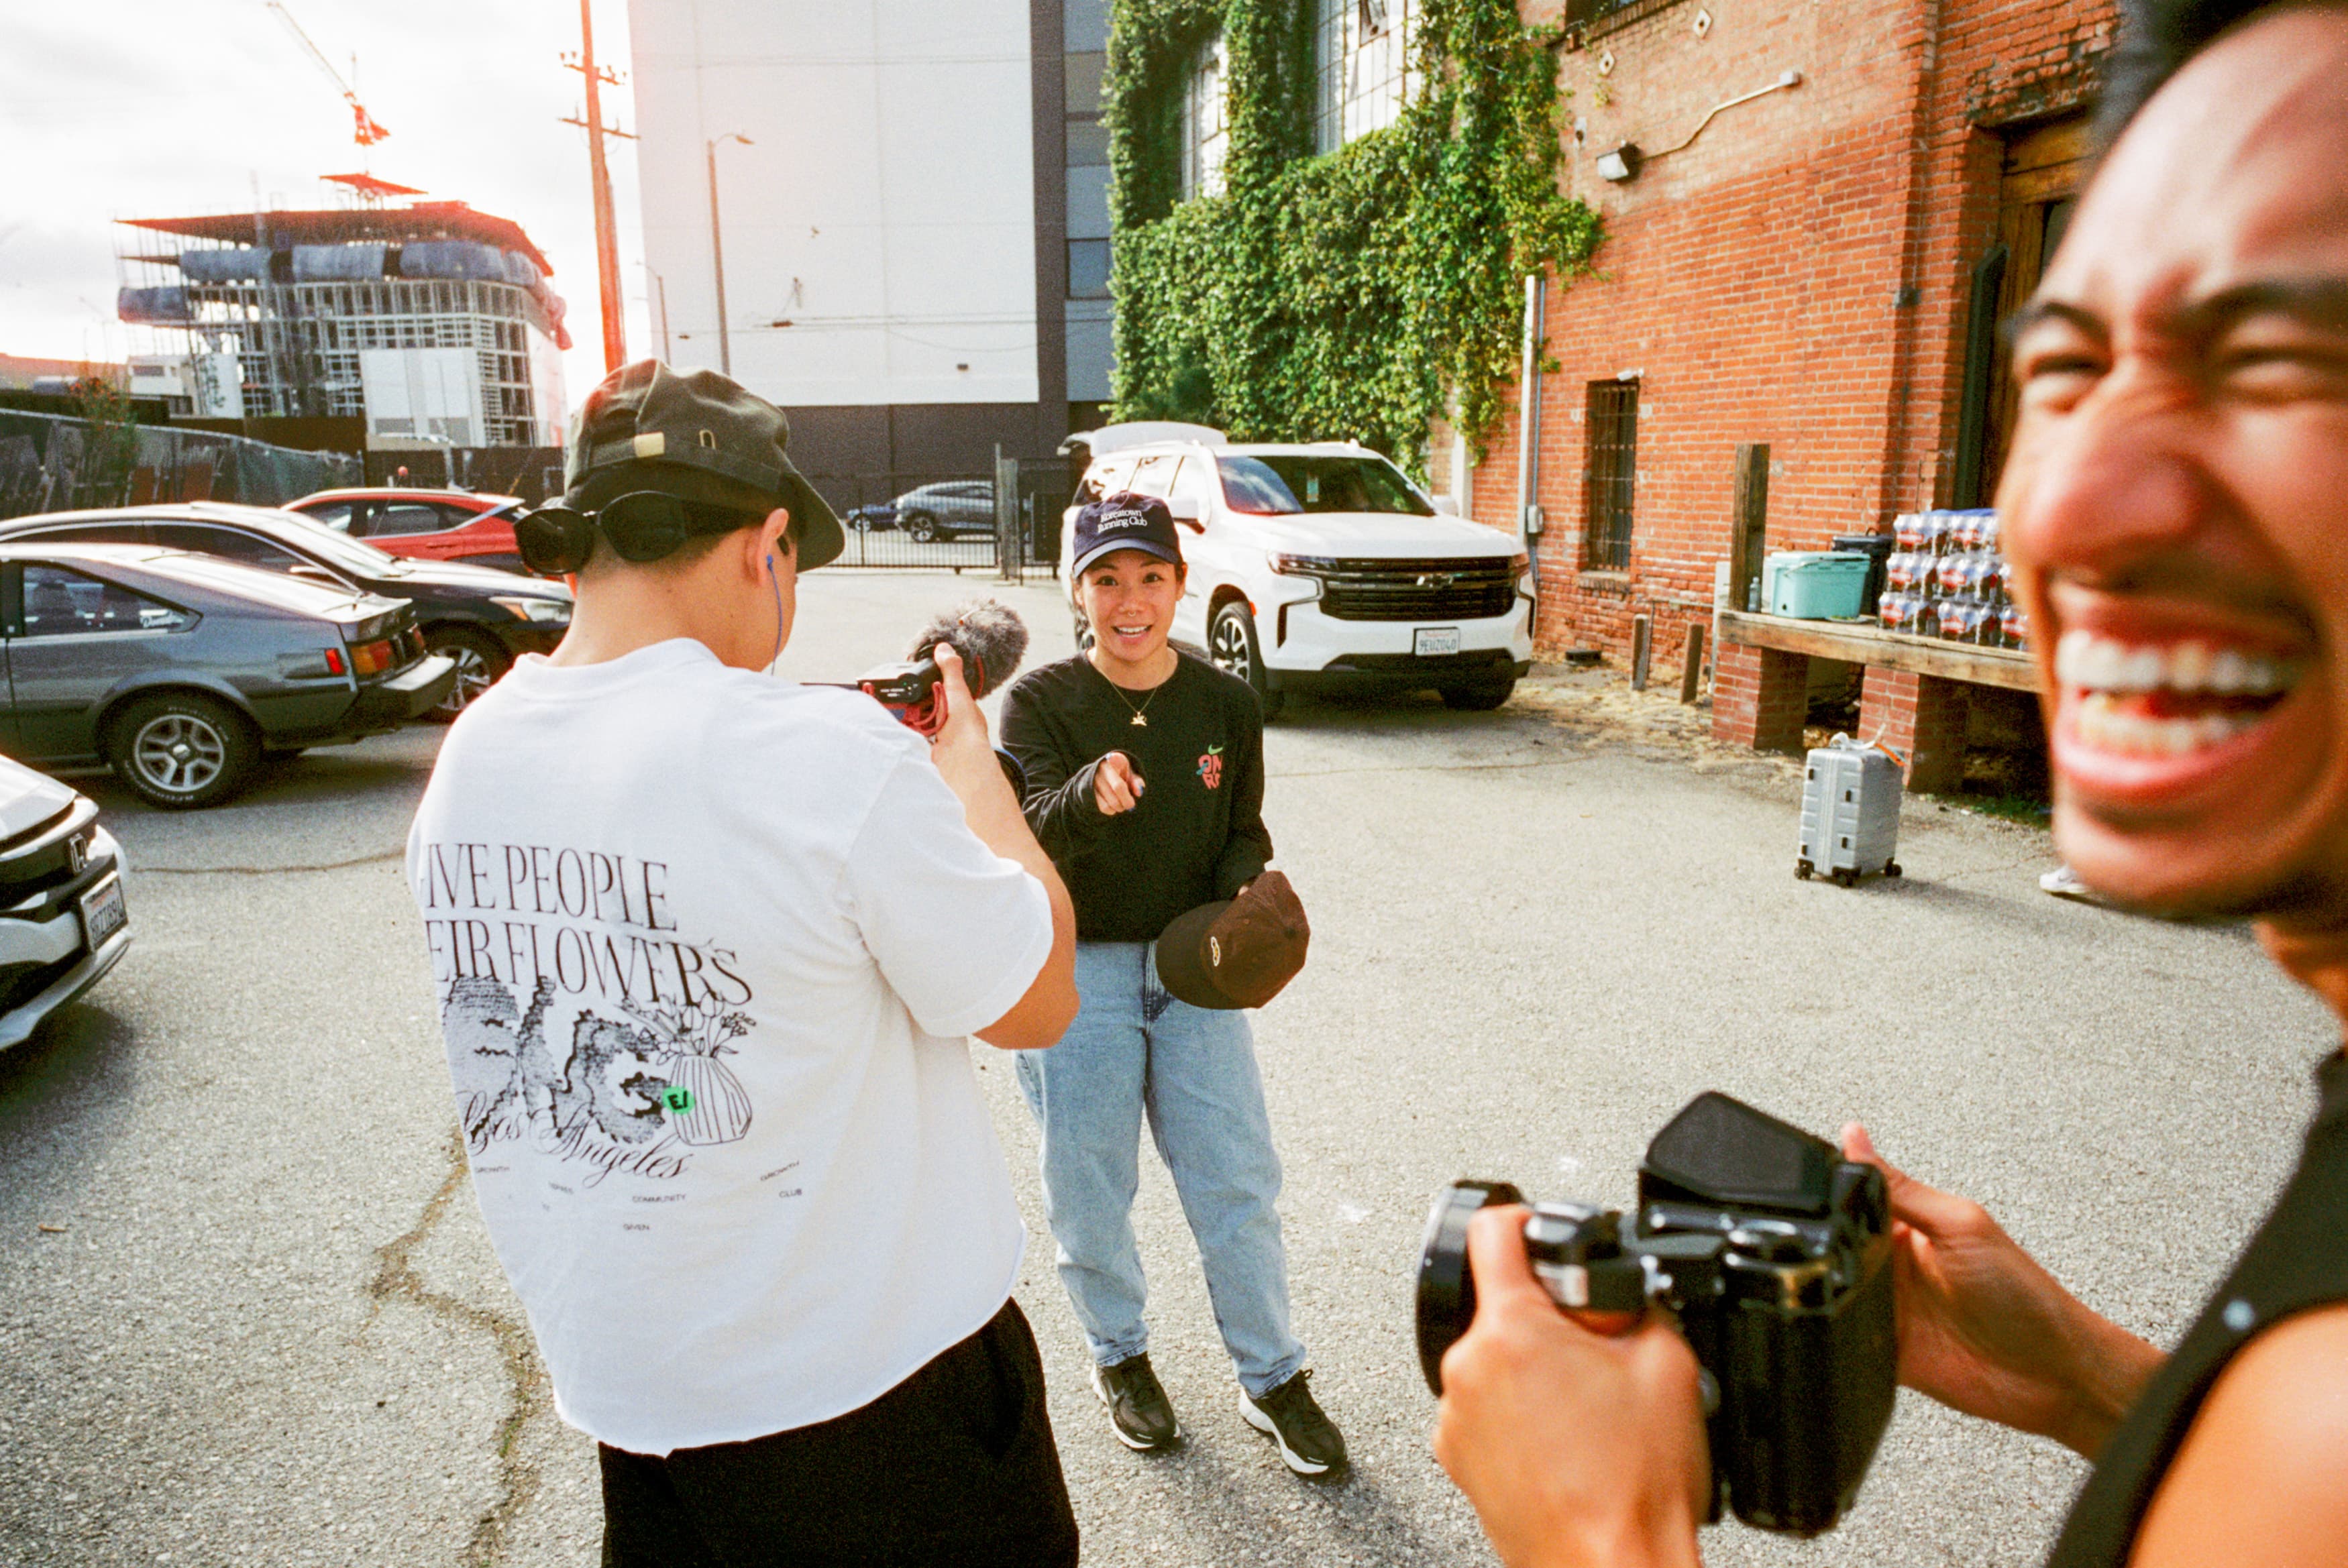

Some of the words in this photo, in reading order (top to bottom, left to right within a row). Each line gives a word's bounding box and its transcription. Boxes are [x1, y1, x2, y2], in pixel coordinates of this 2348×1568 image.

[1098, 519, 1129, 533] Running
[1129, 516, 1148, 526] Club
[421, 843, 496, 908] IVE
[500, 844, 677, 932] PEOPLE
[528, 1102, 694, 1189] Angeles
[632, 1193, 687, 1204] COMMUNITY
[779, 1188, 803, 1198] CLUB
